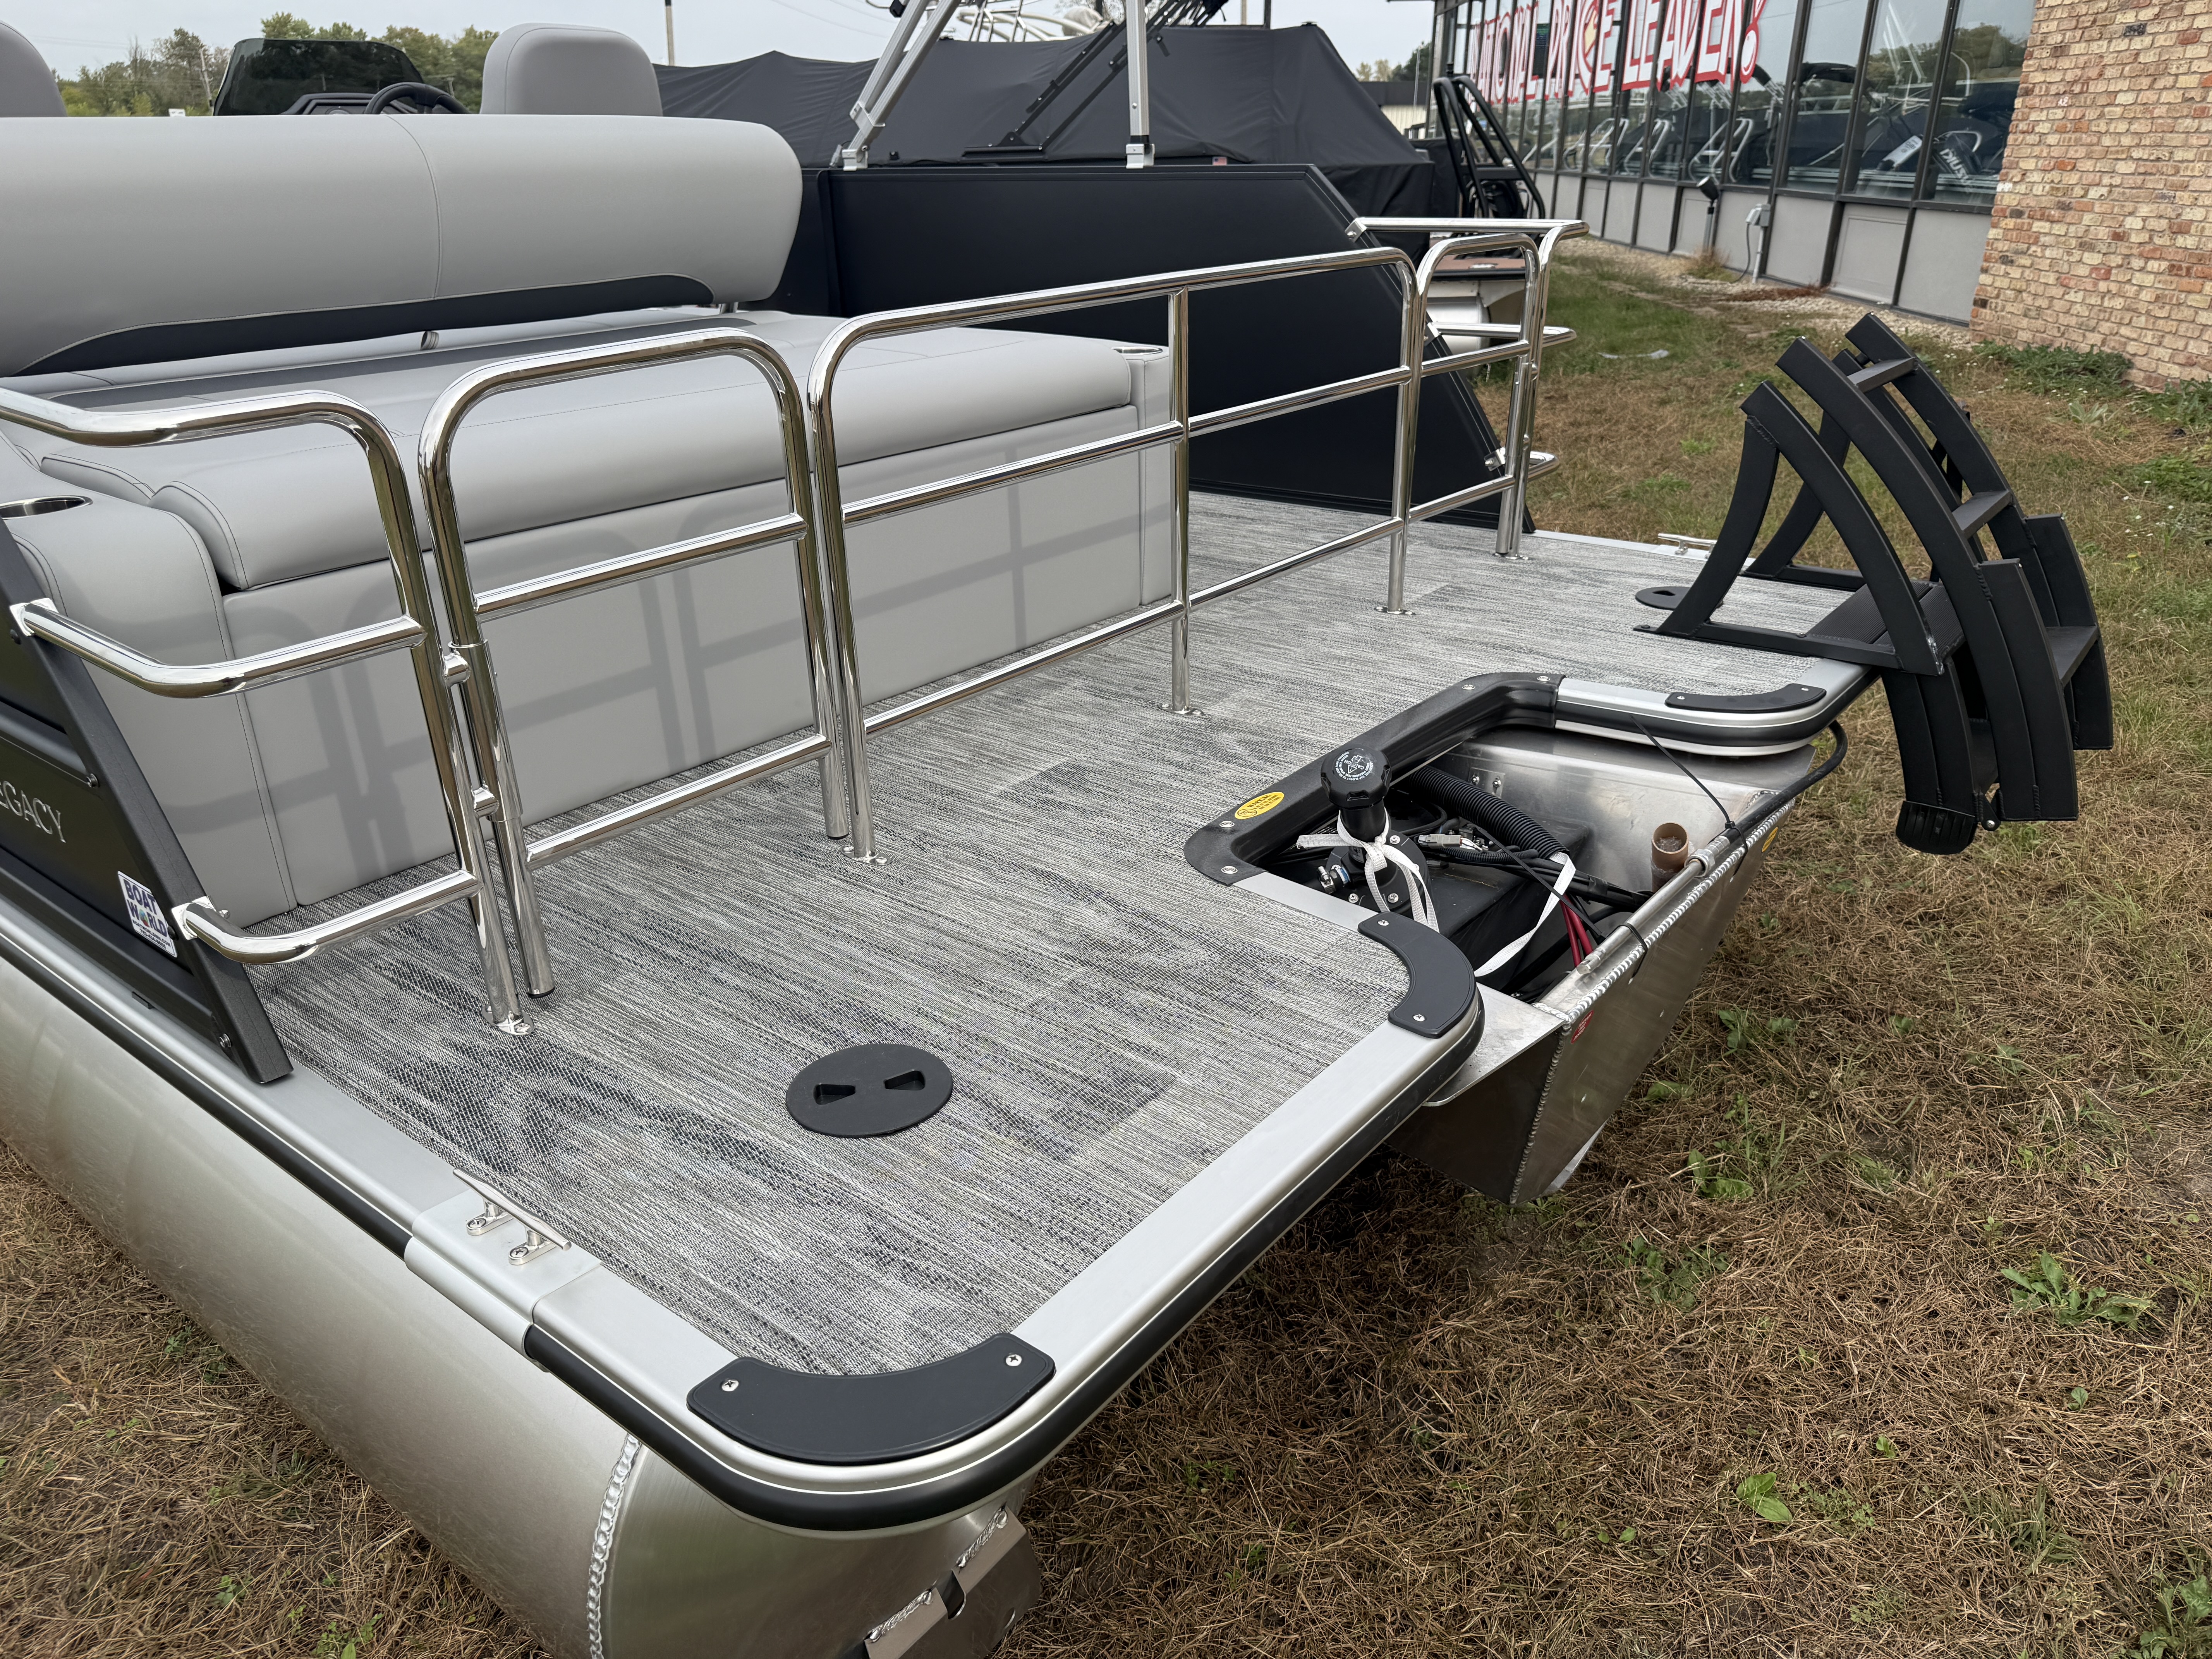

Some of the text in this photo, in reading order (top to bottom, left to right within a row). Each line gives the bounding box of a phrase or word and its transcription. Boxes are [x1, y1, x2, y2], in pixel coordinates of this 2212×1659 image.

[1344, 759, 1364, 770] CAUTION
[0, 781, 66, 843] GACY
[1247, 794, 1272, 808] WARNING
[124, 879, 156, 915] BOAT
[127, 899, 167, 937] WORLD
